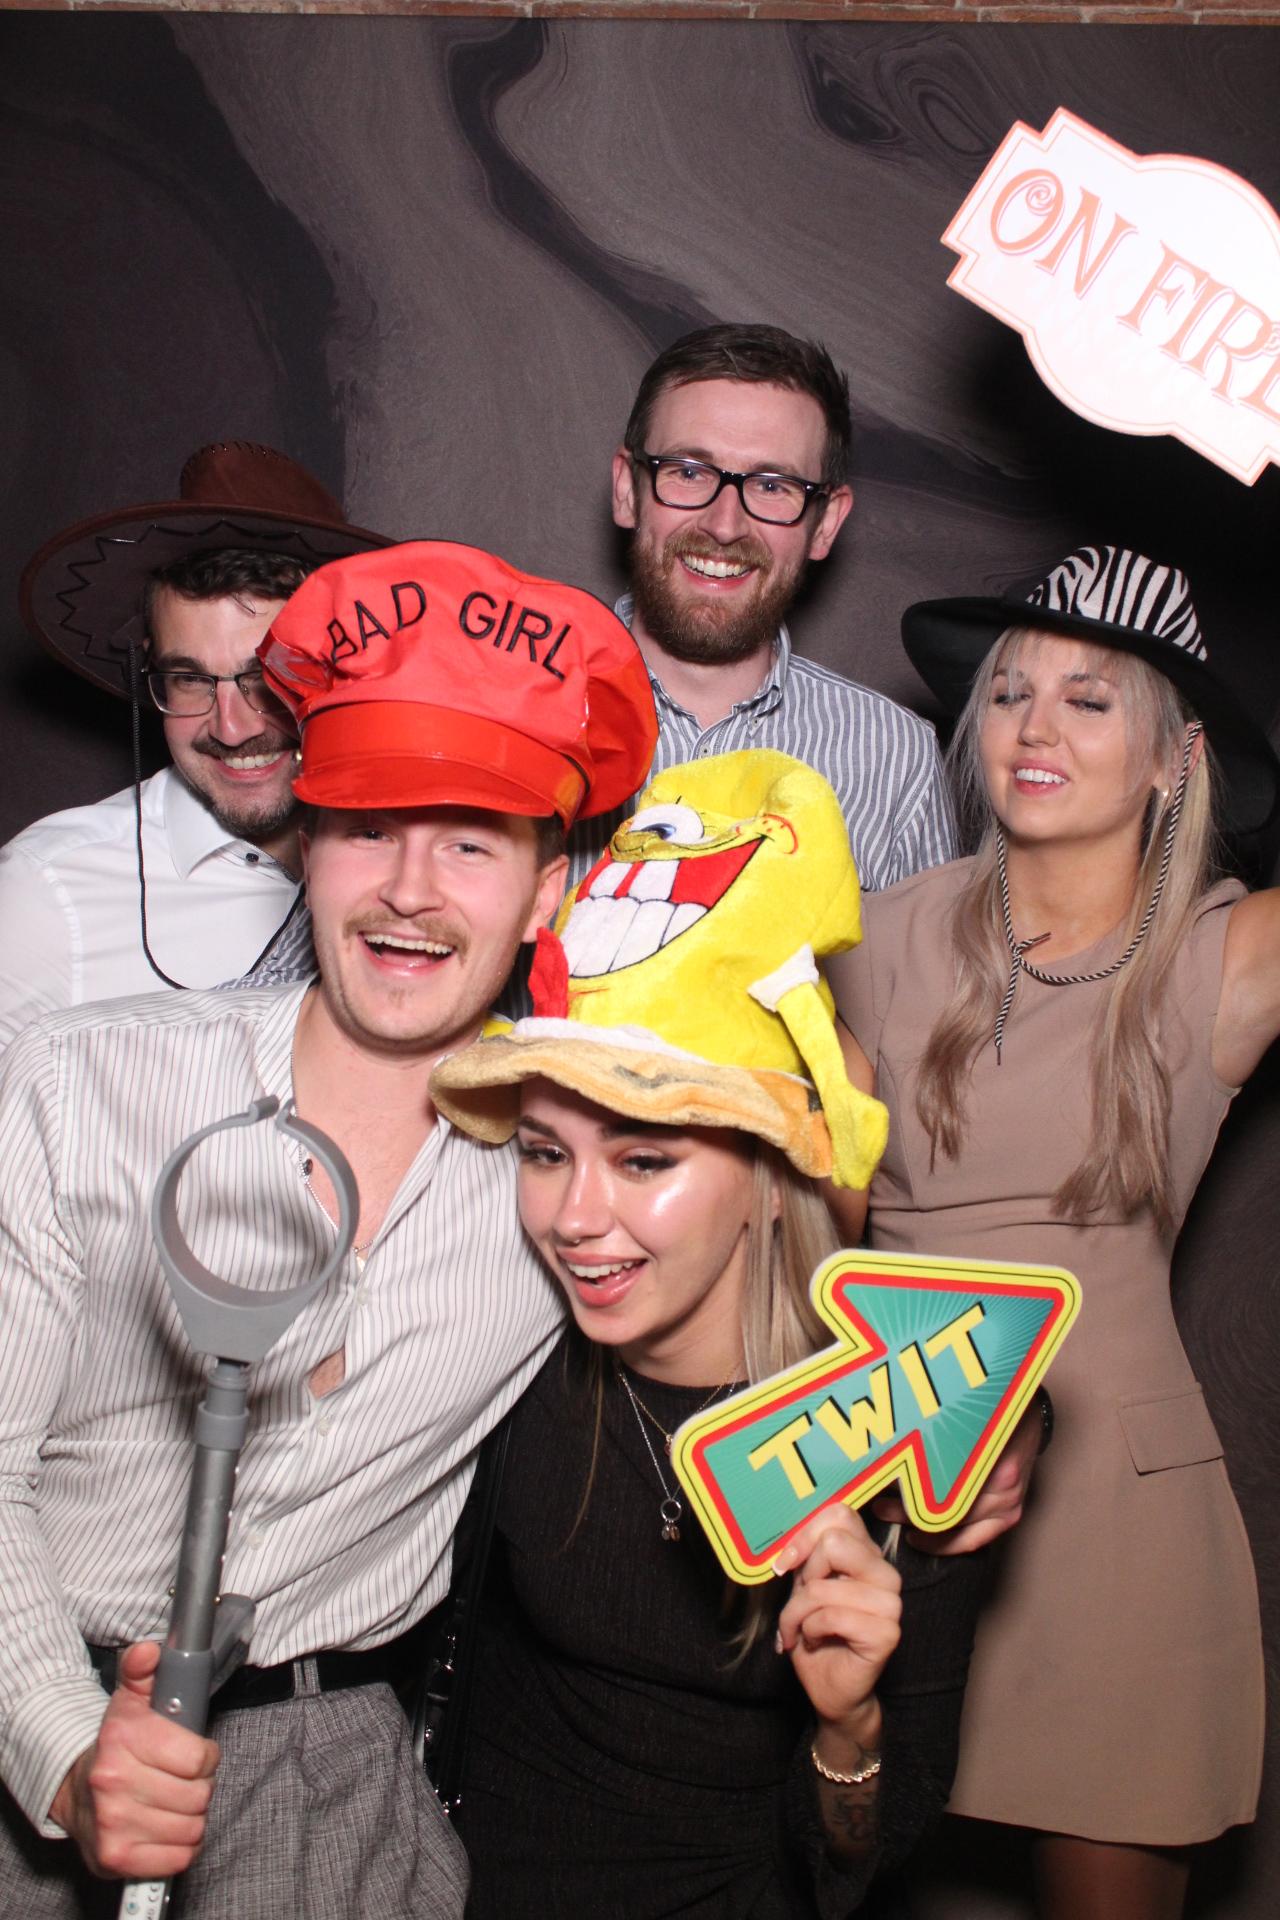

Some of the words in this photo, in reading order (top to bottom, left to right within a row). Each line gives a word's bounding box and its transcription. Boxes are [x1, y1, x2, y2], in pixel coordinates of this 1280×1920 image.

[990, 168, 1139, 300] ON
[326, 581, 428, 664] BAD
[458, 591, 572, 682] GIRL
[746, 1301, 989, 1500] TWIT
